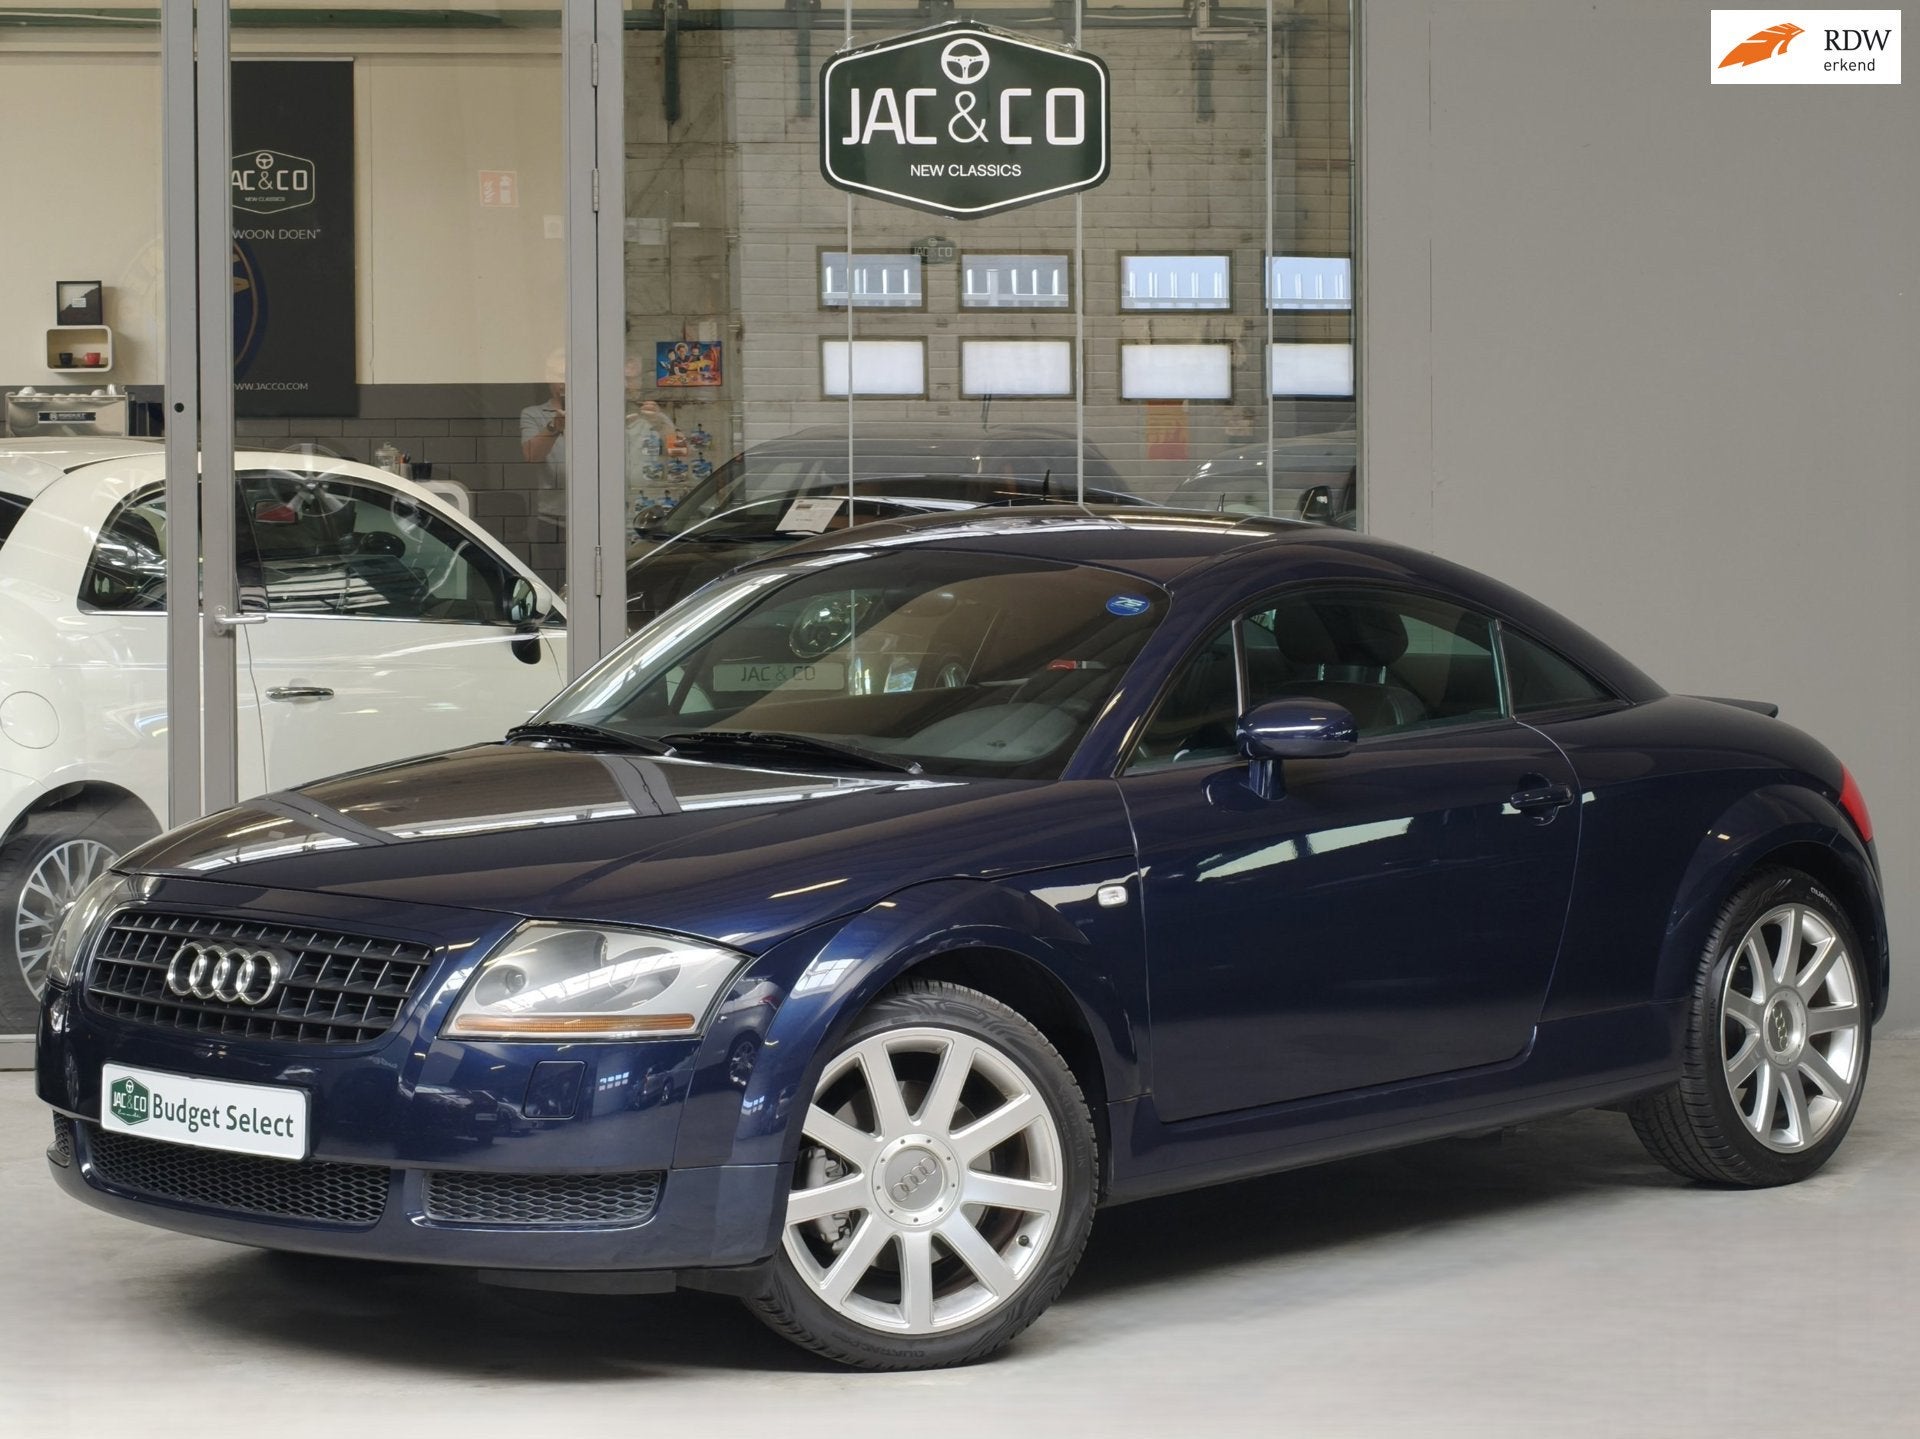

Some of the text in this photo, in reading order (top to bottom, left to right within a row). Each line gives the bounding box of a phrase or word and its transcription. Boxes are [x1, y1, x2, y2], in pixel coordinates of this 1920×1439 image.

[910, 163, 1022, 178] NEW CLASSICS
[152, 1093, 294, 1138] Budget Select
